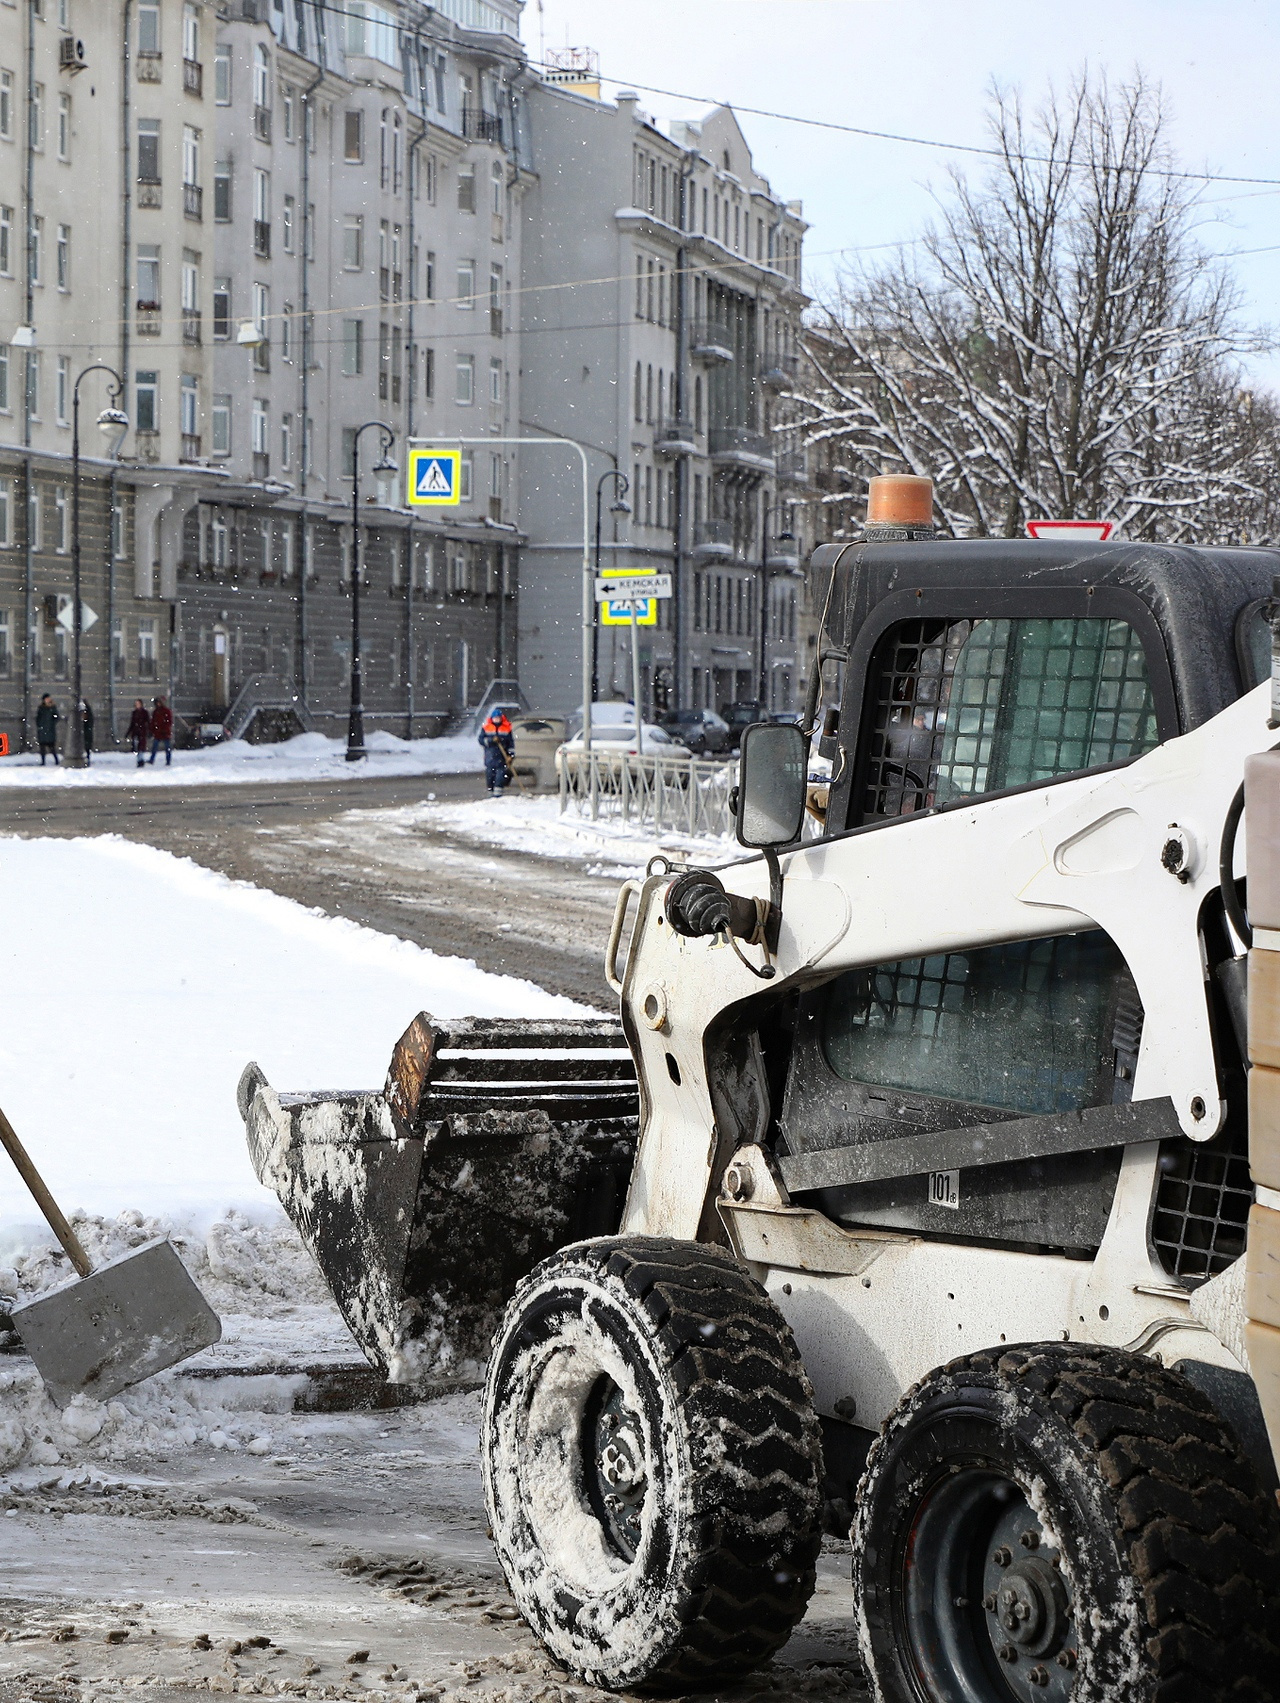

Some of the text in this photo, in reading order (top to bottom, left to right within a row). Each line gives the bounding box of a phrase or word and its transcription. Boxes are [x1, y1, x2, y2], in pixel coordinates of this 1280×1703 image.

[619, 577, 669, 588] КЕМСКАЯ
[931, 1172, 957, 1204] 101 dB
